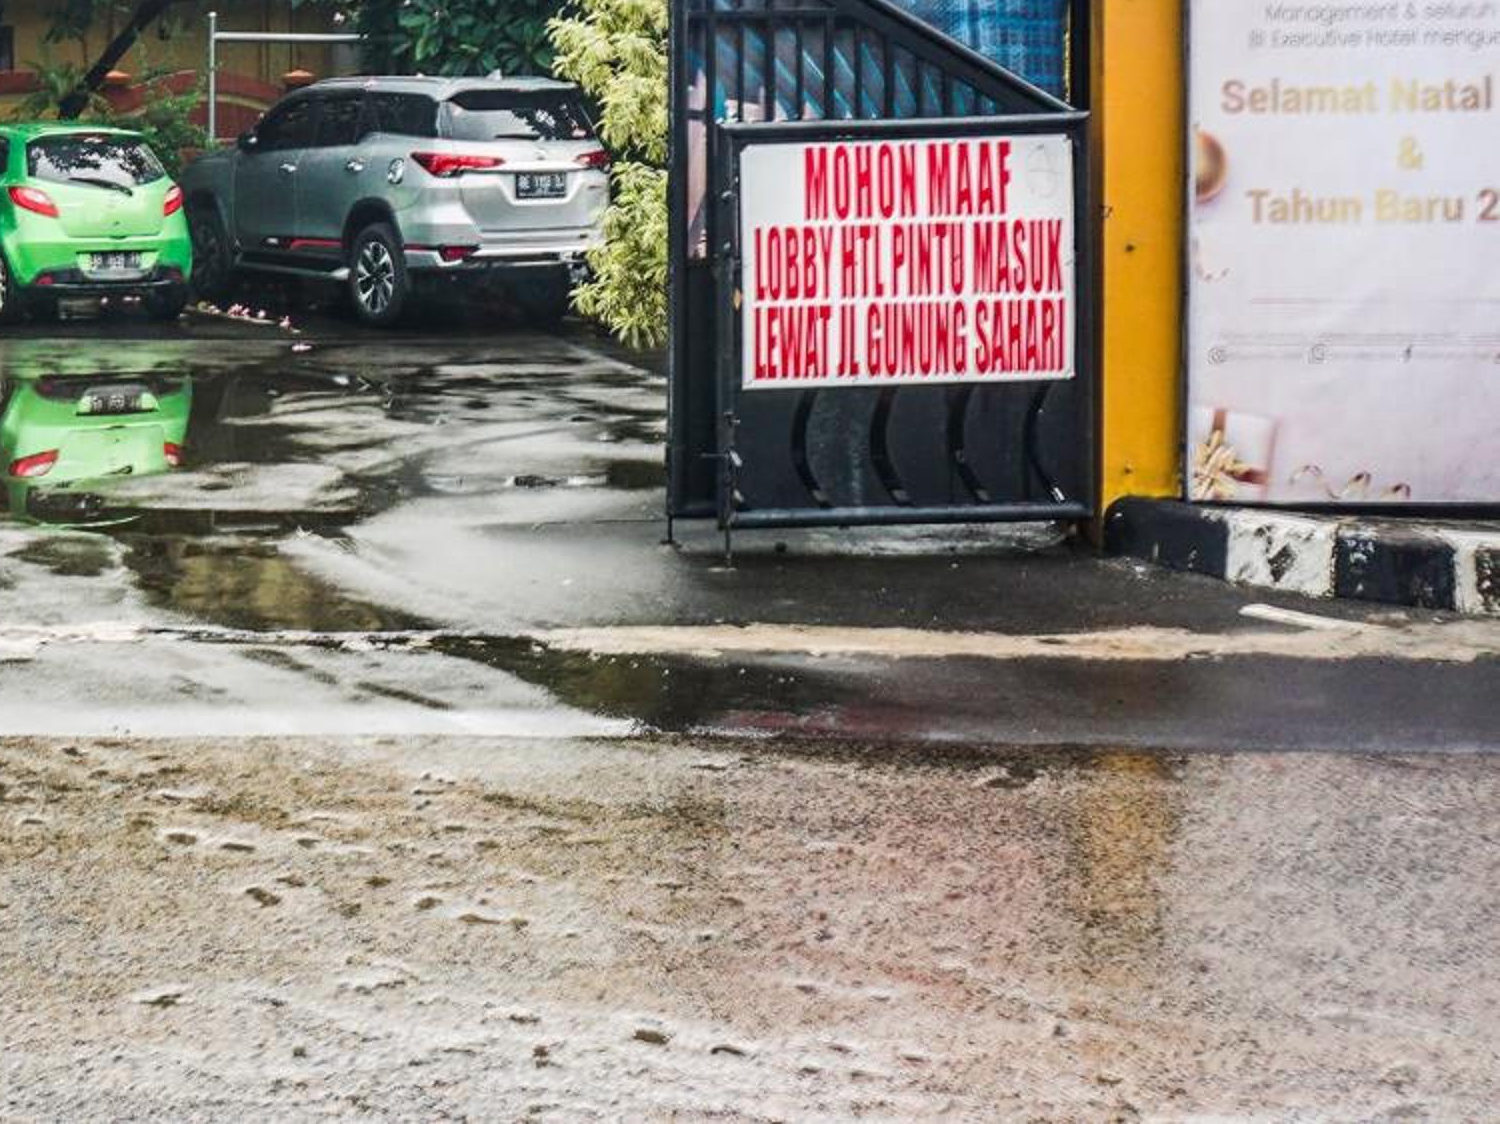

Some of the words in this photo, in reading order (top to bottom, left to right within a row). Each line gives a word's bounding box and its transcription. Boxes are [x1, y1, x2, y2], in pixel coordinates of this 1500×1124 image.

[1220, 78, 1379, 115] Selamat
[1388, 75, 1492, 112] Natal
[804, 143, 918, 220] MOHON
[926, 141, 1012, 217] MAAF
[1398, 136, 1424, 170] &
[1246, 188, 1364, 223] Tahun
[1374, 187, 1465, 223] Baru
[753, 226, 833, 300] LOBBY
[841, 224, 884, 297] HTL
[893, 222, 965, 296] PINTU
[972, 218, 1063, 294] MASUK
[754, 305, 832, 380] LEWAT
[837, 303, 860, 376] JL
[867, 301, 967, 377] GUNUNG
[974, 298, 1065, 374] SAHARI
